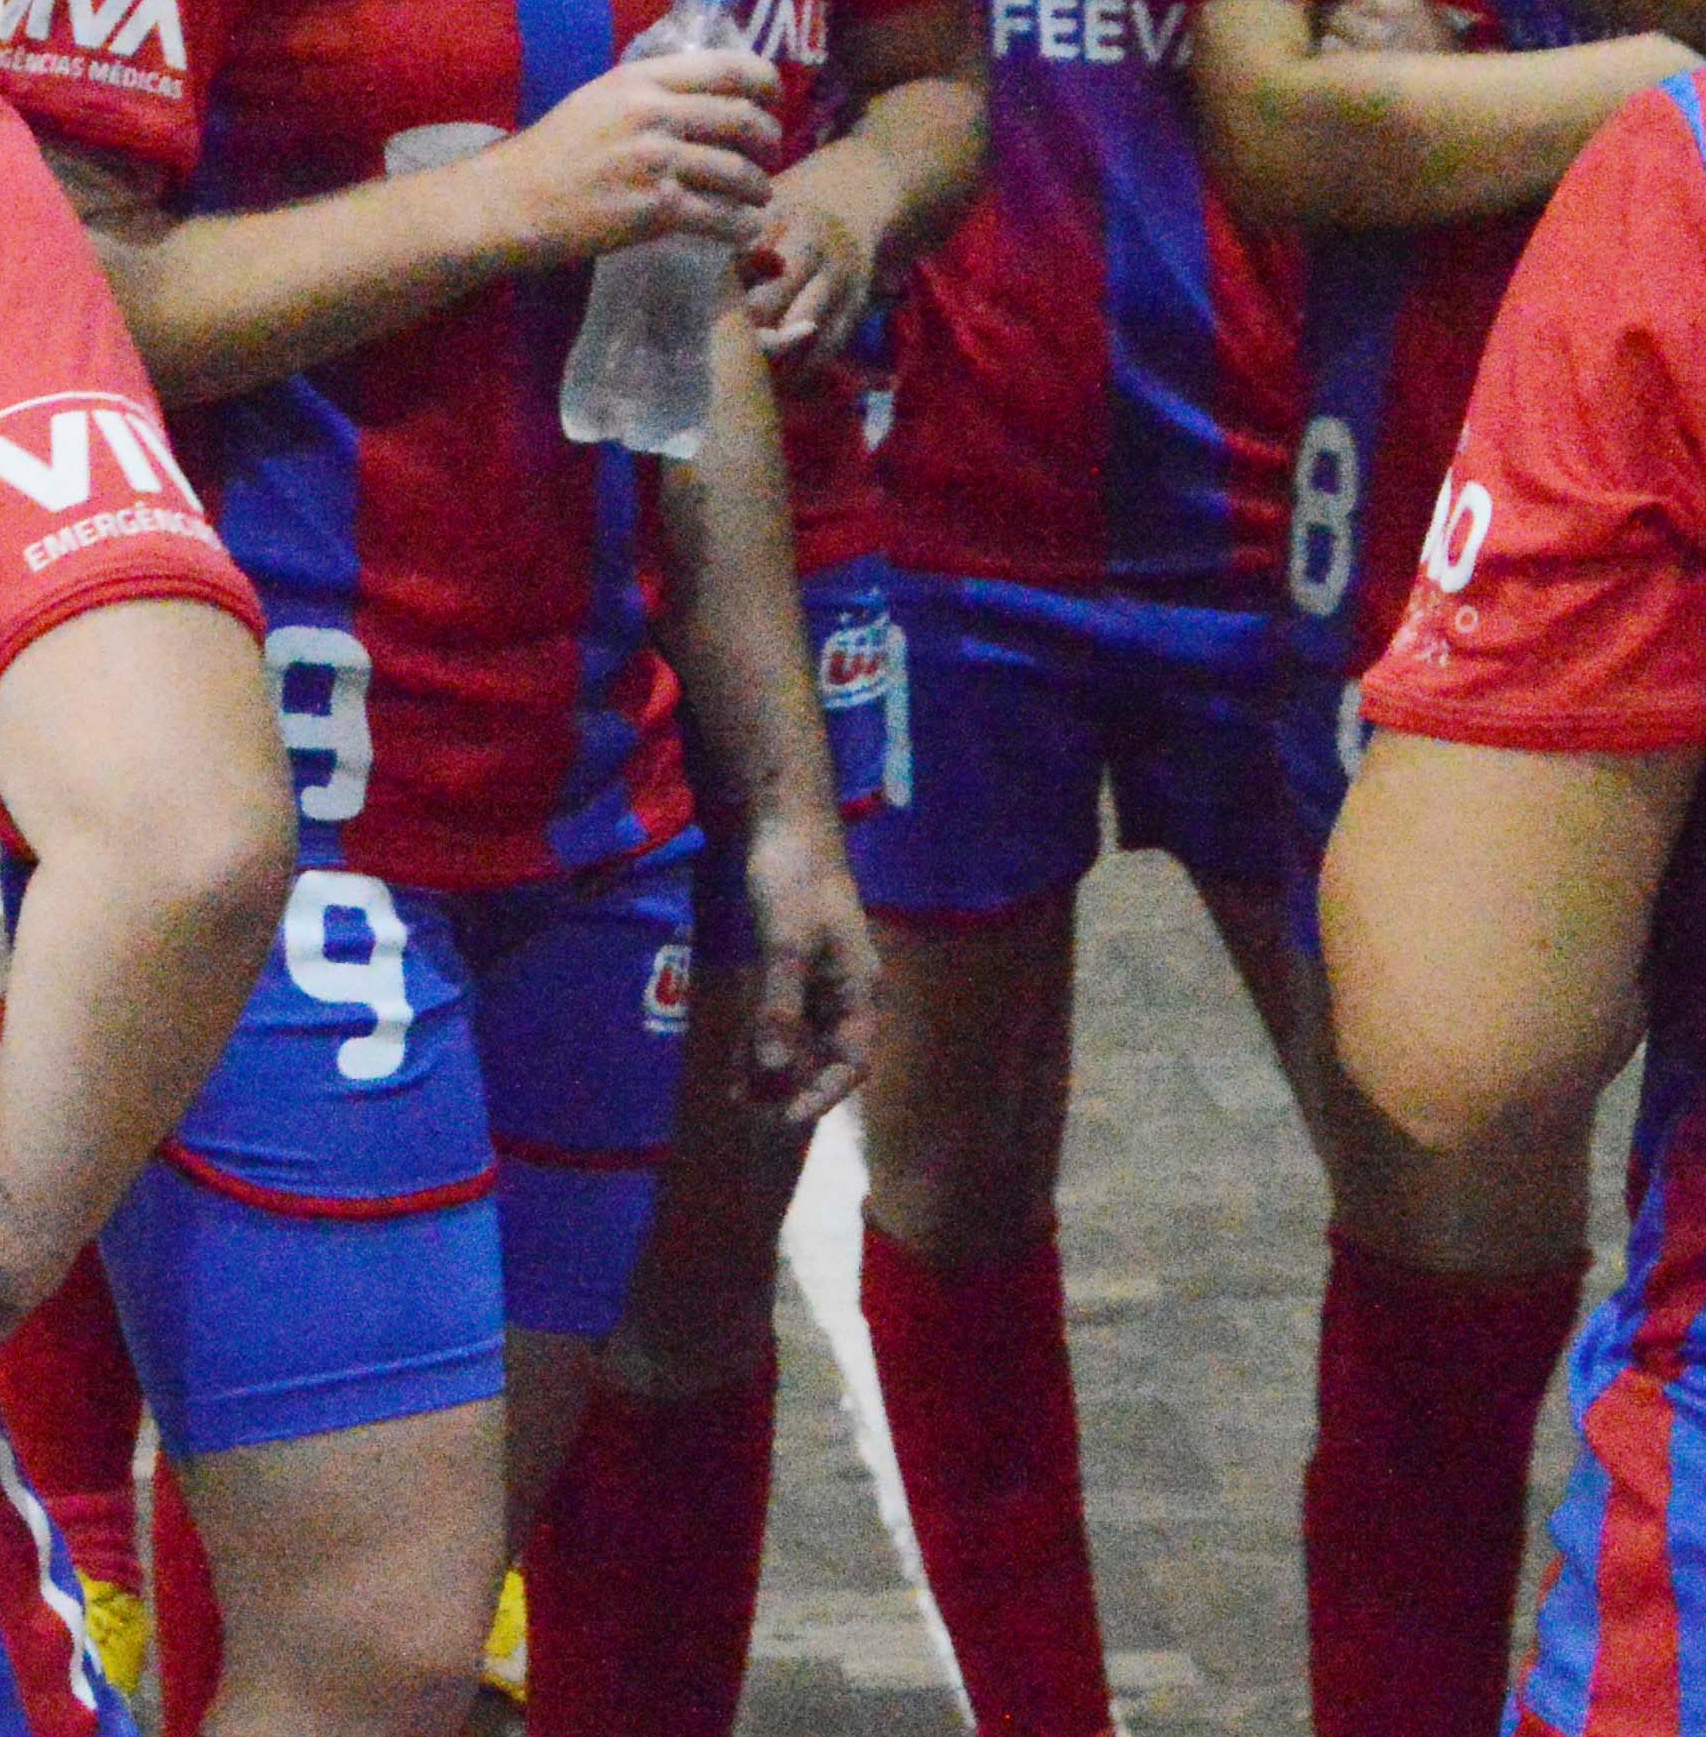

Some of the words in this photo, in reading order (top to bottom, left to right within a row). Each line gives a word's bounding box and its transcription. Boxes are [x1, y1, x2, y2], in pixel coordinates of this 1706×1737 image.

[22, 500, 226, 574] EMERGÊNC
[1290, 415, 1358, 617] 8
[264, 624, 375, 822] 9
[283, 868, 415, 1081] 9
